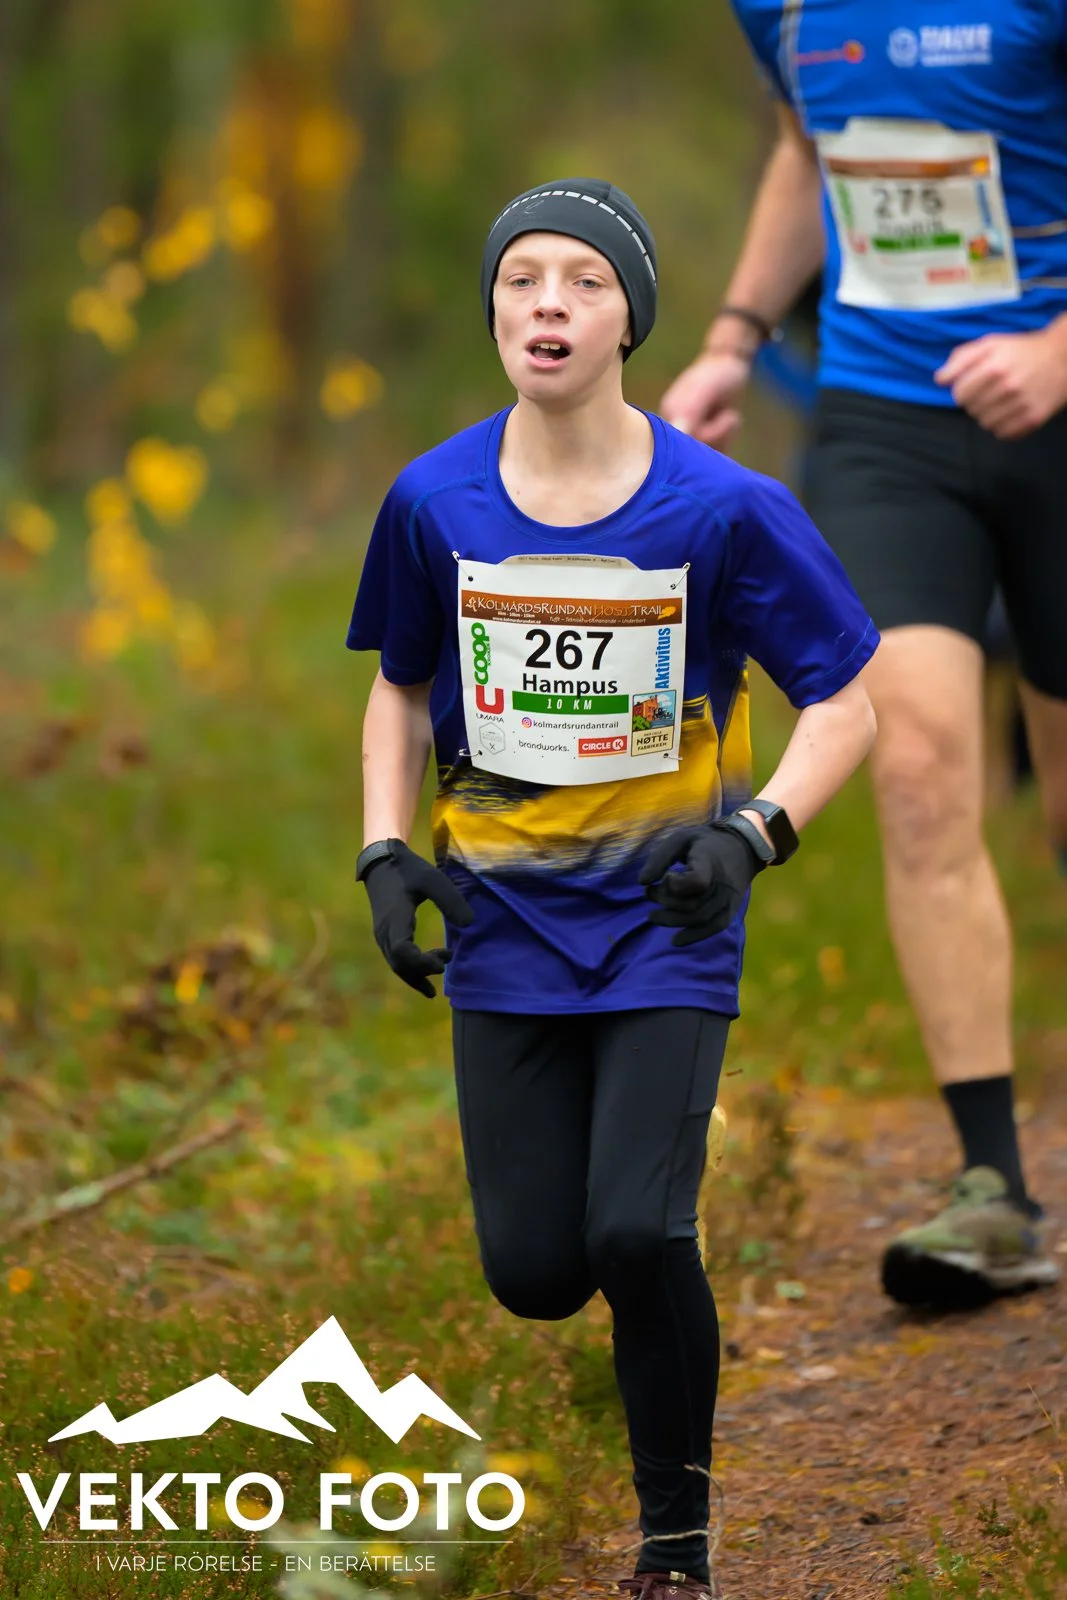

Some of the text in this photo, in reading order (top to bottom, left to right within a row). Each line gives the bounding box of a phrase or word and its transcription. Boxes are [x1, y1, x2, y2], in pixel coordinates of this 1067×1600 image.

[525, 628, 614, 670] 267
[655, 627, 671, 689] Aktivitus
[523, 673, 618, 699] Hampus
[475, 713, 505, 723] UMARA
[533, 720, 619, 730] kolmardsrundantrail
[518, 739, 570, 752] brandworks.
[636, 733, 669, 746] NØTTE
[581, 742, 611, 751] CIRCLE
